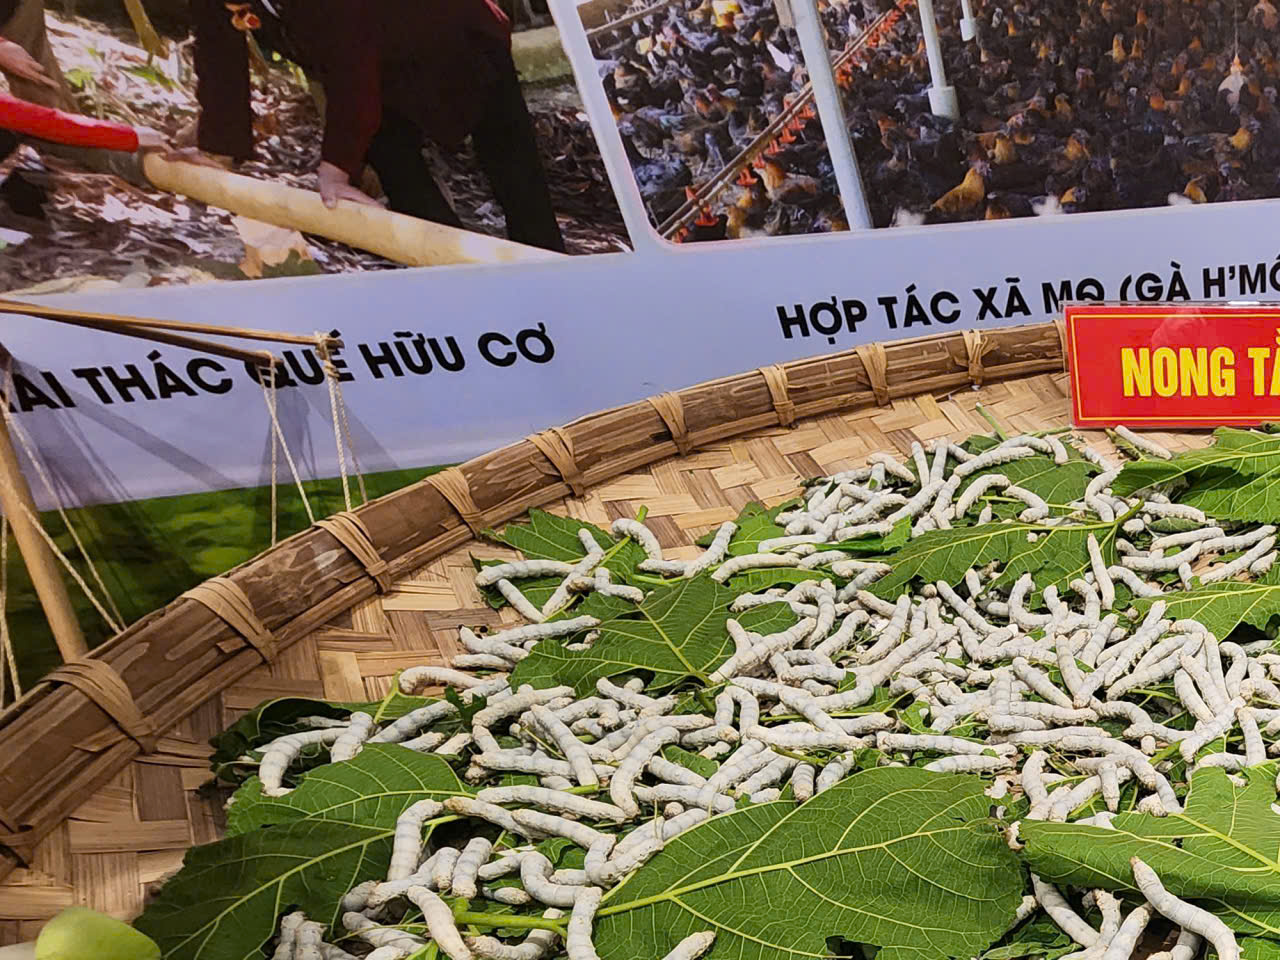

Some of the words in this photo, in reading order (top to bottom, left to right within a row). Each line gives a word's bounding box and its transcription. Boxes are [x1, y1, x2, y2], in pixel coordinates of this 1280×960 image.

[776, 296, 868, 345] HỢP
[877, 283, 962, 328] TÁC
[972, 277, 1032, 321] XÃ
[1119, 260, 1191, 304] (GÀ
[0, 371, 77, 413] AI
[71, 350, 232, 404] THÁC
[358, 331, 465, 378] HỮU
[477, 322, 556, 367] CƠ
[1121, 346, 1236, 397] NONG
